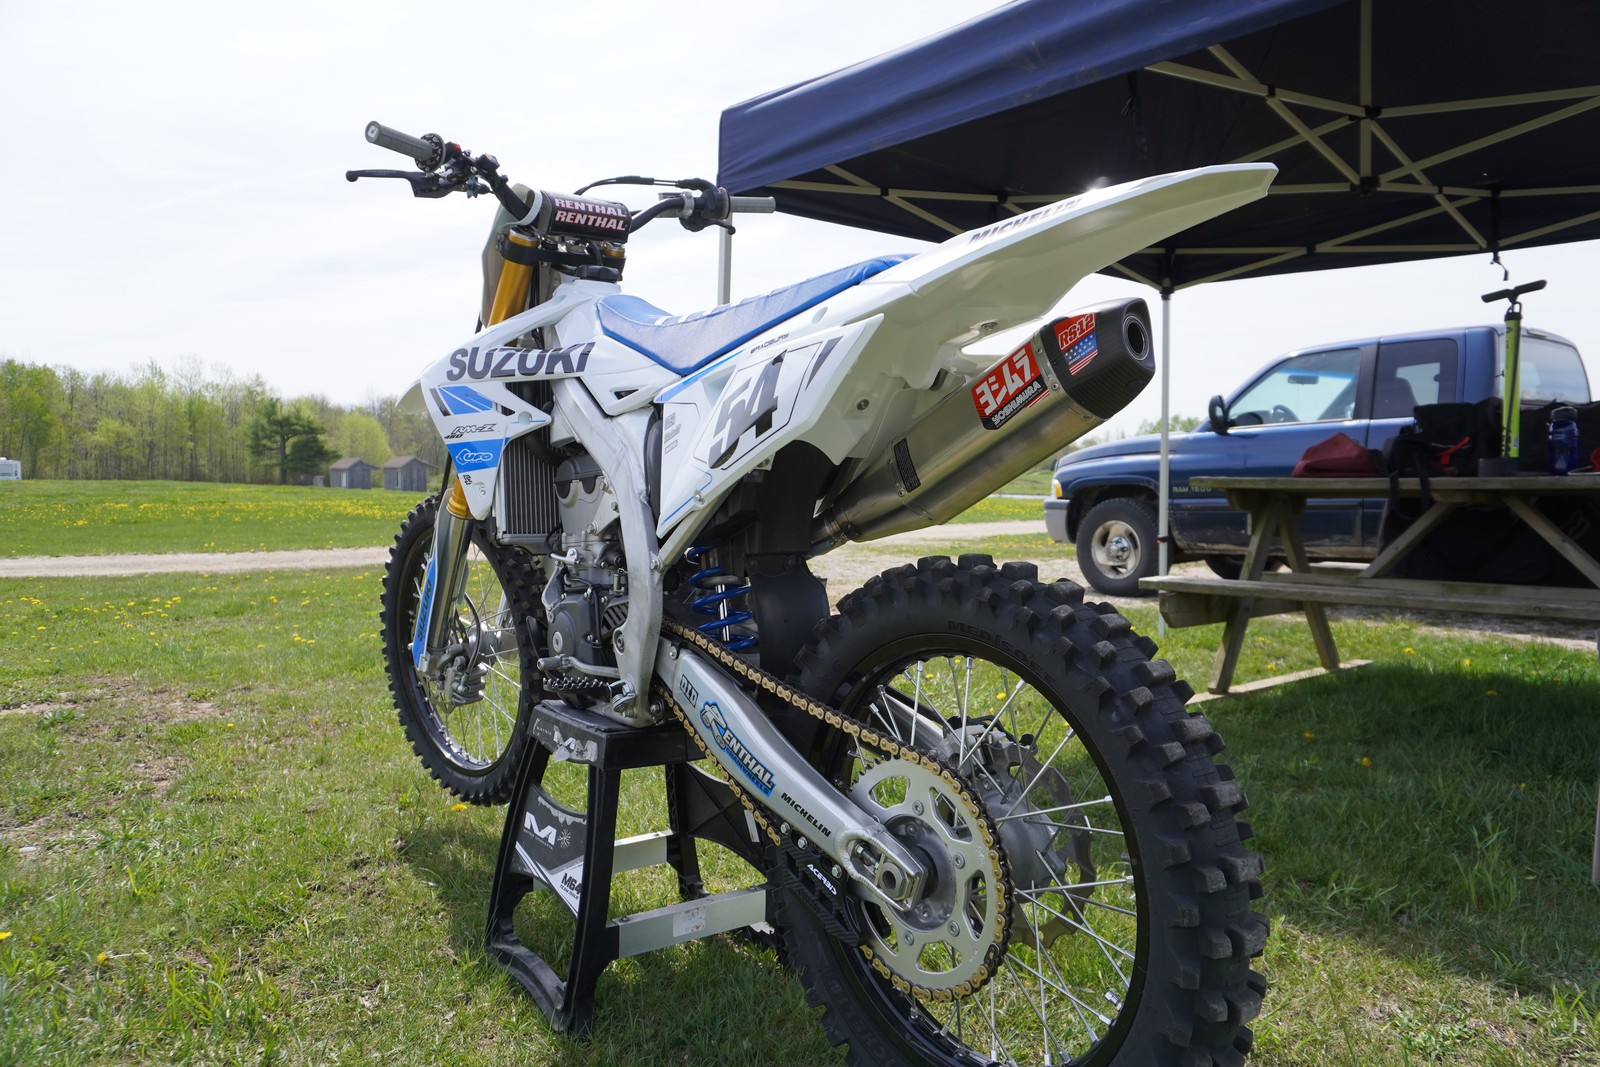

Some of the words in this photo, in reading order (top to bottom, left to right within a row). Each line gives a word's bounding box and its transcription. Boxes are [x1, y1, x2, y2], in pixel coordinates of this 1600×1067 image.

[554, 198, 627, 217] RENTHAL
[555, 210, 626, 231] RENTHAL
[446, 342, 596, 382] SUZUKI
[708, 349, 788, 470] 54
[991, 380, 1042, 426] YOSHIMURA
[1172, 485, 1189, 493] RAM
[417, 578, 433, 642] SUZUKI
[780, 792, 832, 838] MICHELIN
